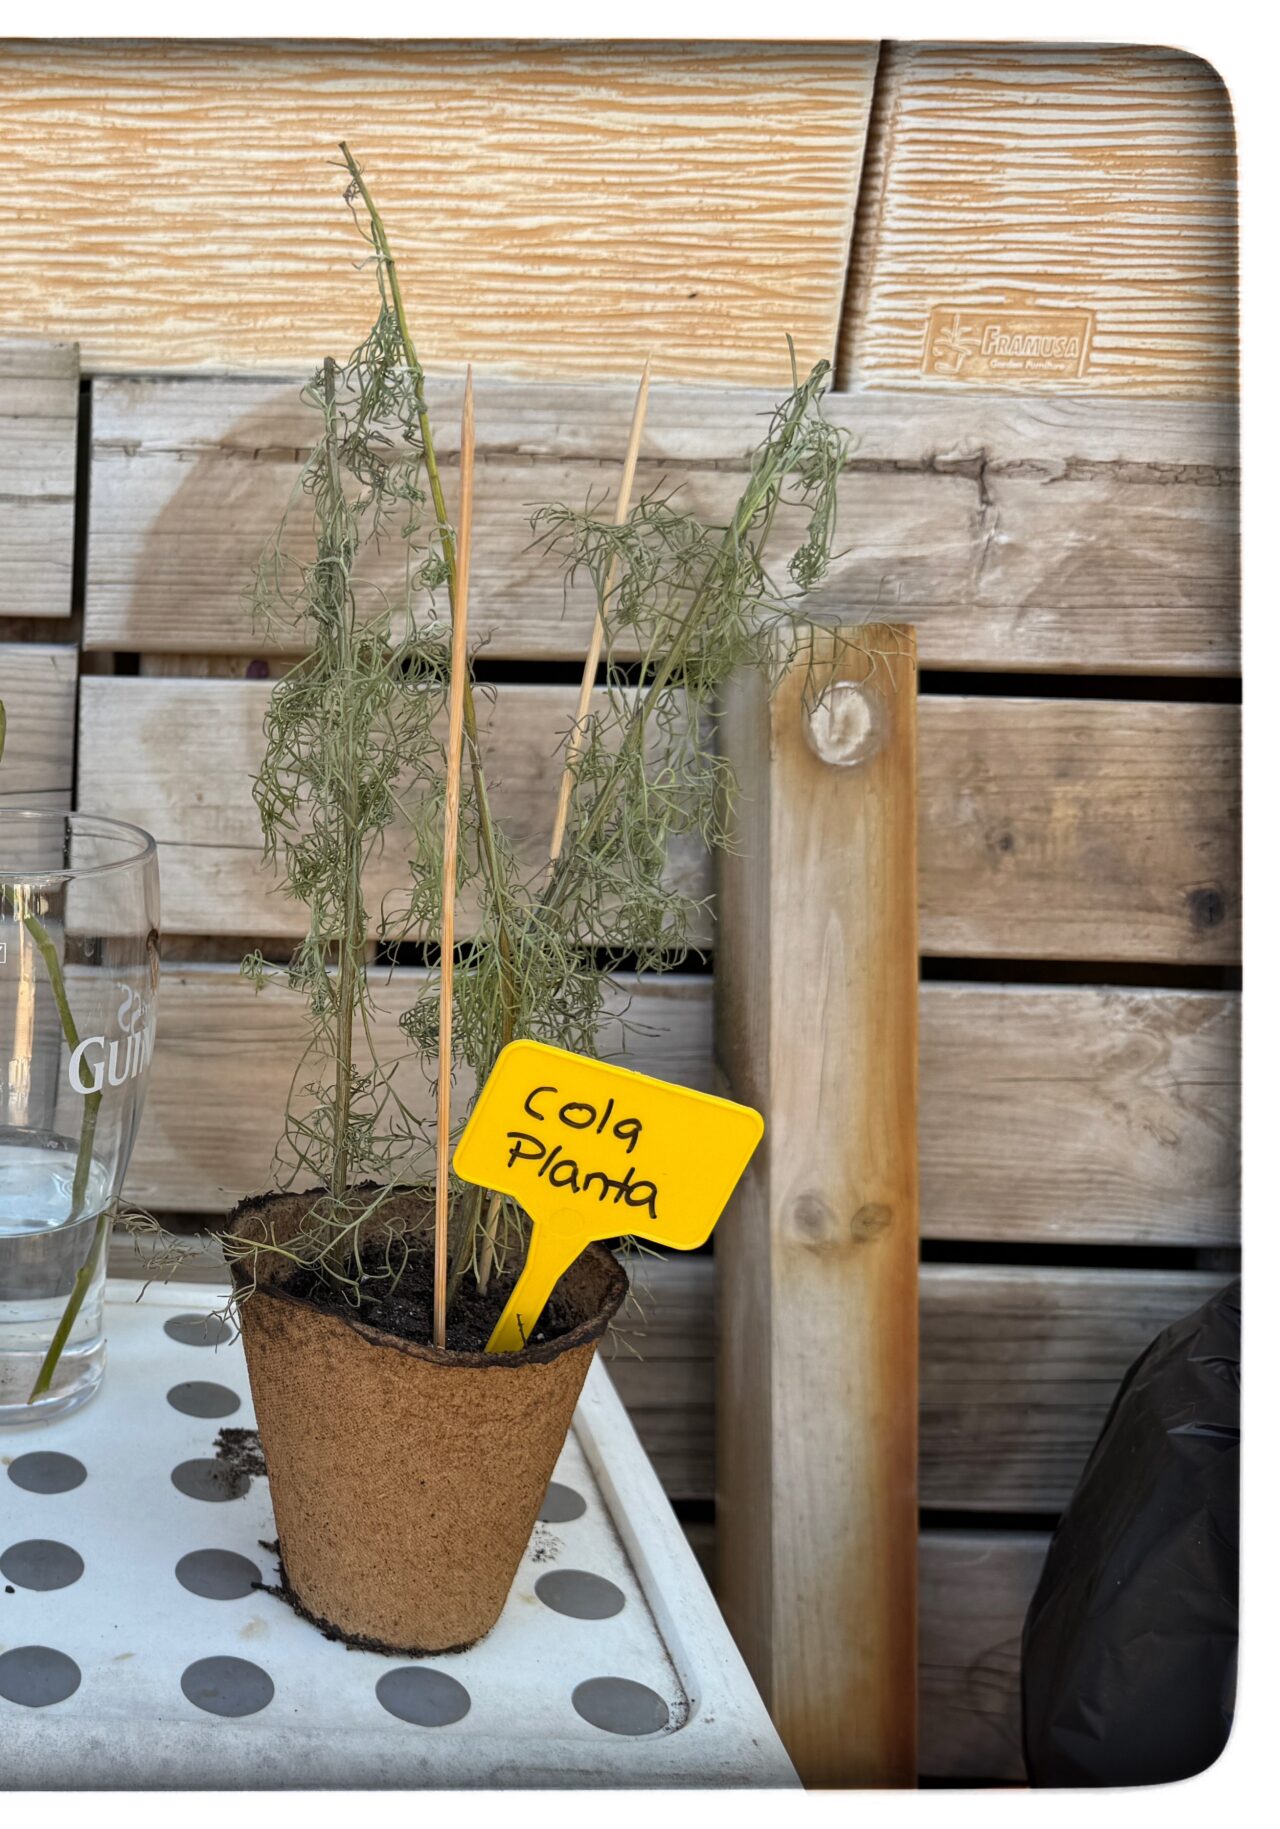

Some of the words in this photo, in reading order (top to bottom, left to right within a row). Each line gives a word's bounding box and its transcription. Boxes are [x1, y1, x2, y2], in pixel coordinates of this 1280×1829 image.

[981, 325, 1080, 358] FRAMUSA
[524, 1086, 643, 1154] Cola
[507, 1131, 658, 1219] Planta
